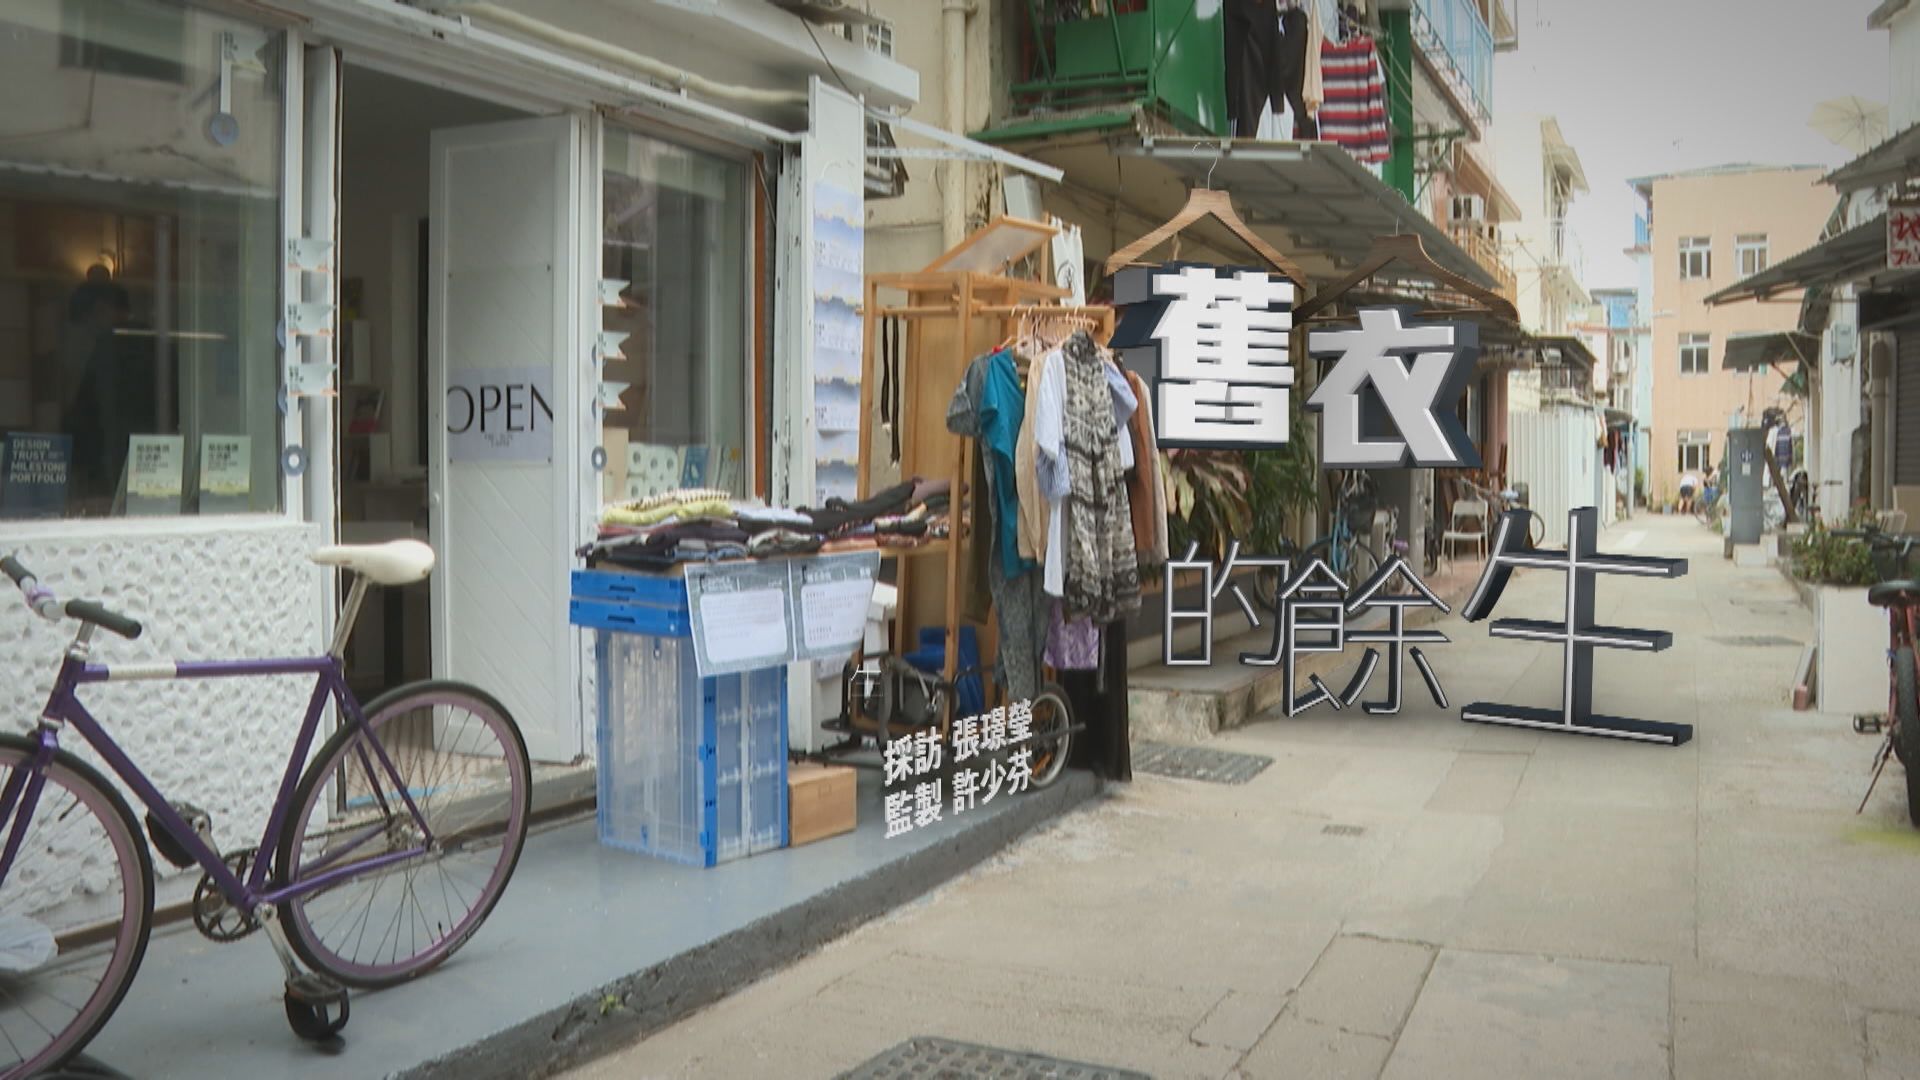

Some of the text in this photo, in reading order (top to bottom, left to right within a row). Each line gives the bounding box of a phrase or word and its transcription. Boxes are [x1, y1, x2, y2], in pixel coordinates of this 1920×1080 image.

[447, 384, 553, 434] OPEN
[12, 439, 50, 450] DESIGN
[12, 450, 46, 461] TRUST
[10, 461, 66, 473] MILESTONE
[9, 472, 66, 484] PORTFOLIO
